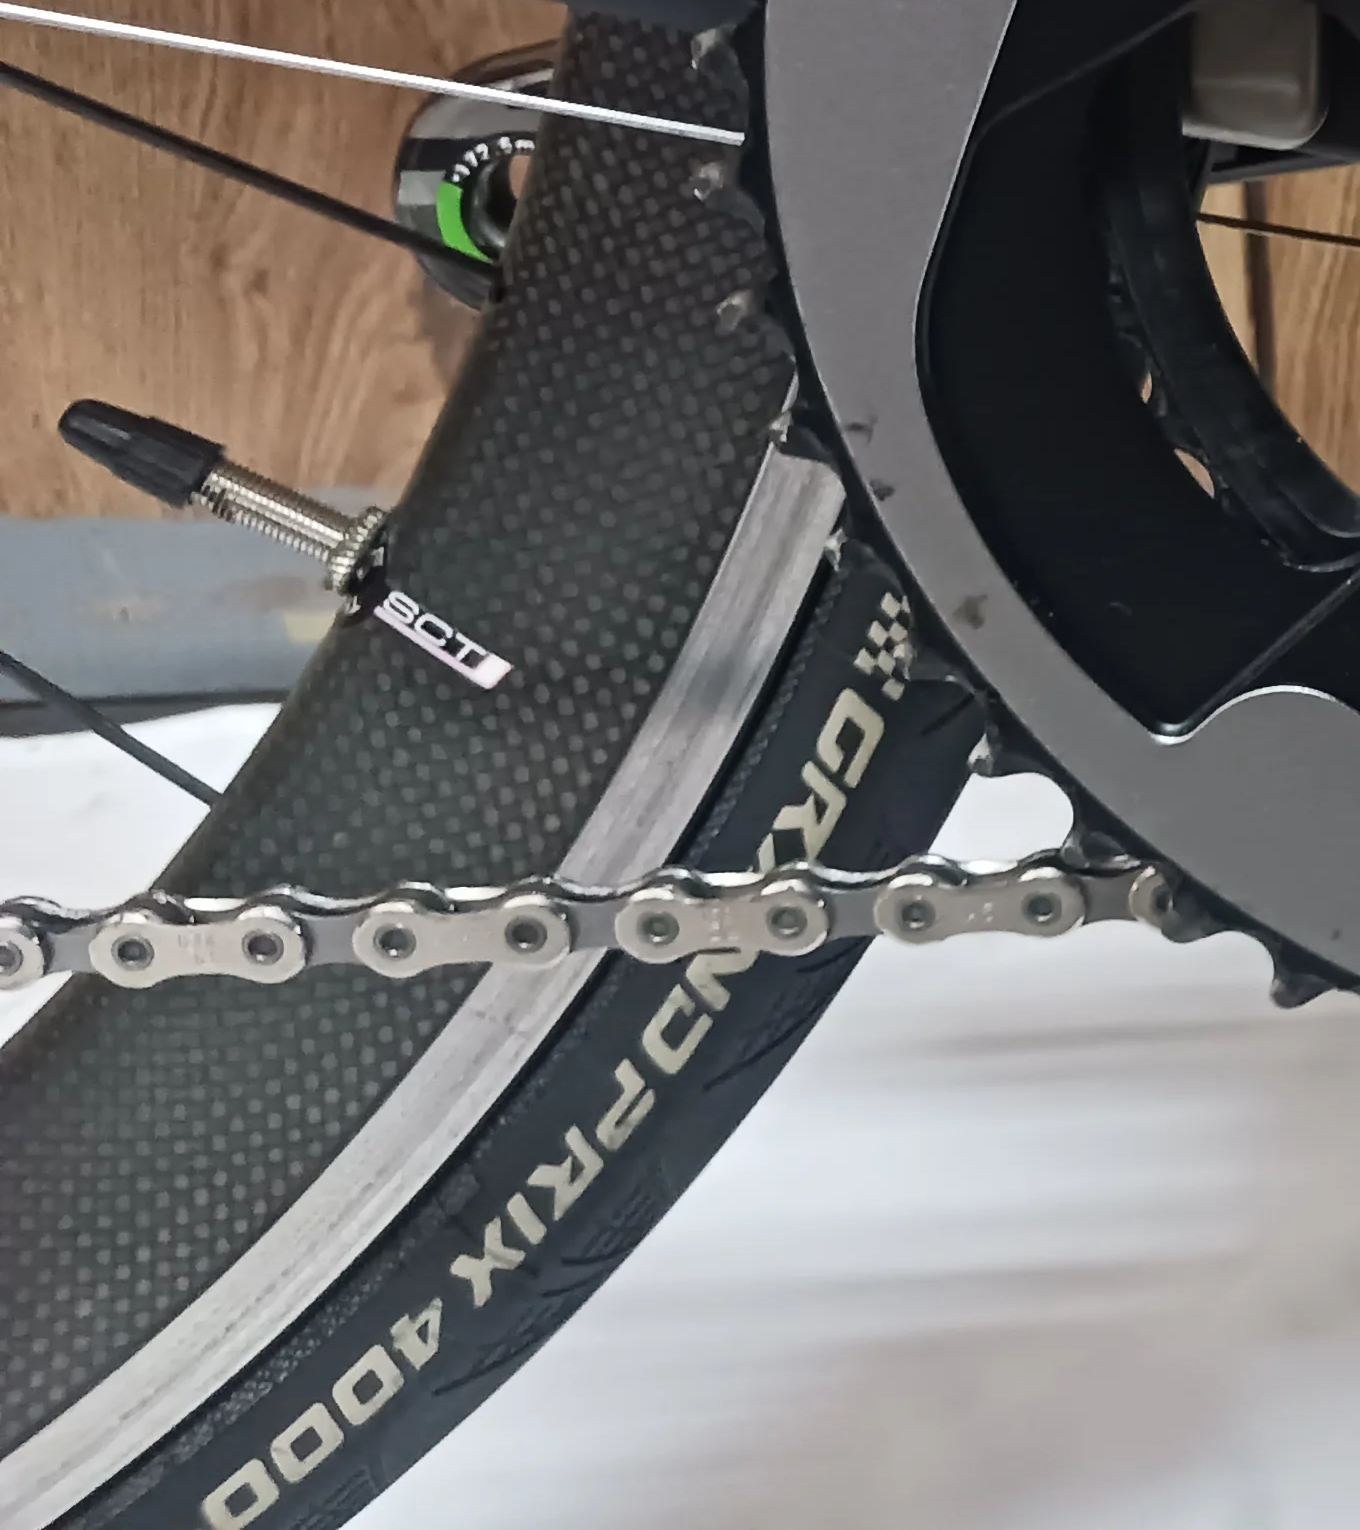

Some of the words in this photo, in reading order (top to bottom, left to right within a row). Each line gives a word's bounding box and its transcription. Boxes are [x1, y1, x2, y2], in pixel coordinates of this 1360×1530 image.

[382, 590, 488, 662] SCT
[450, 1057, 657, 1309] PRIX
[200, 1297, 443, 1530] 4000
